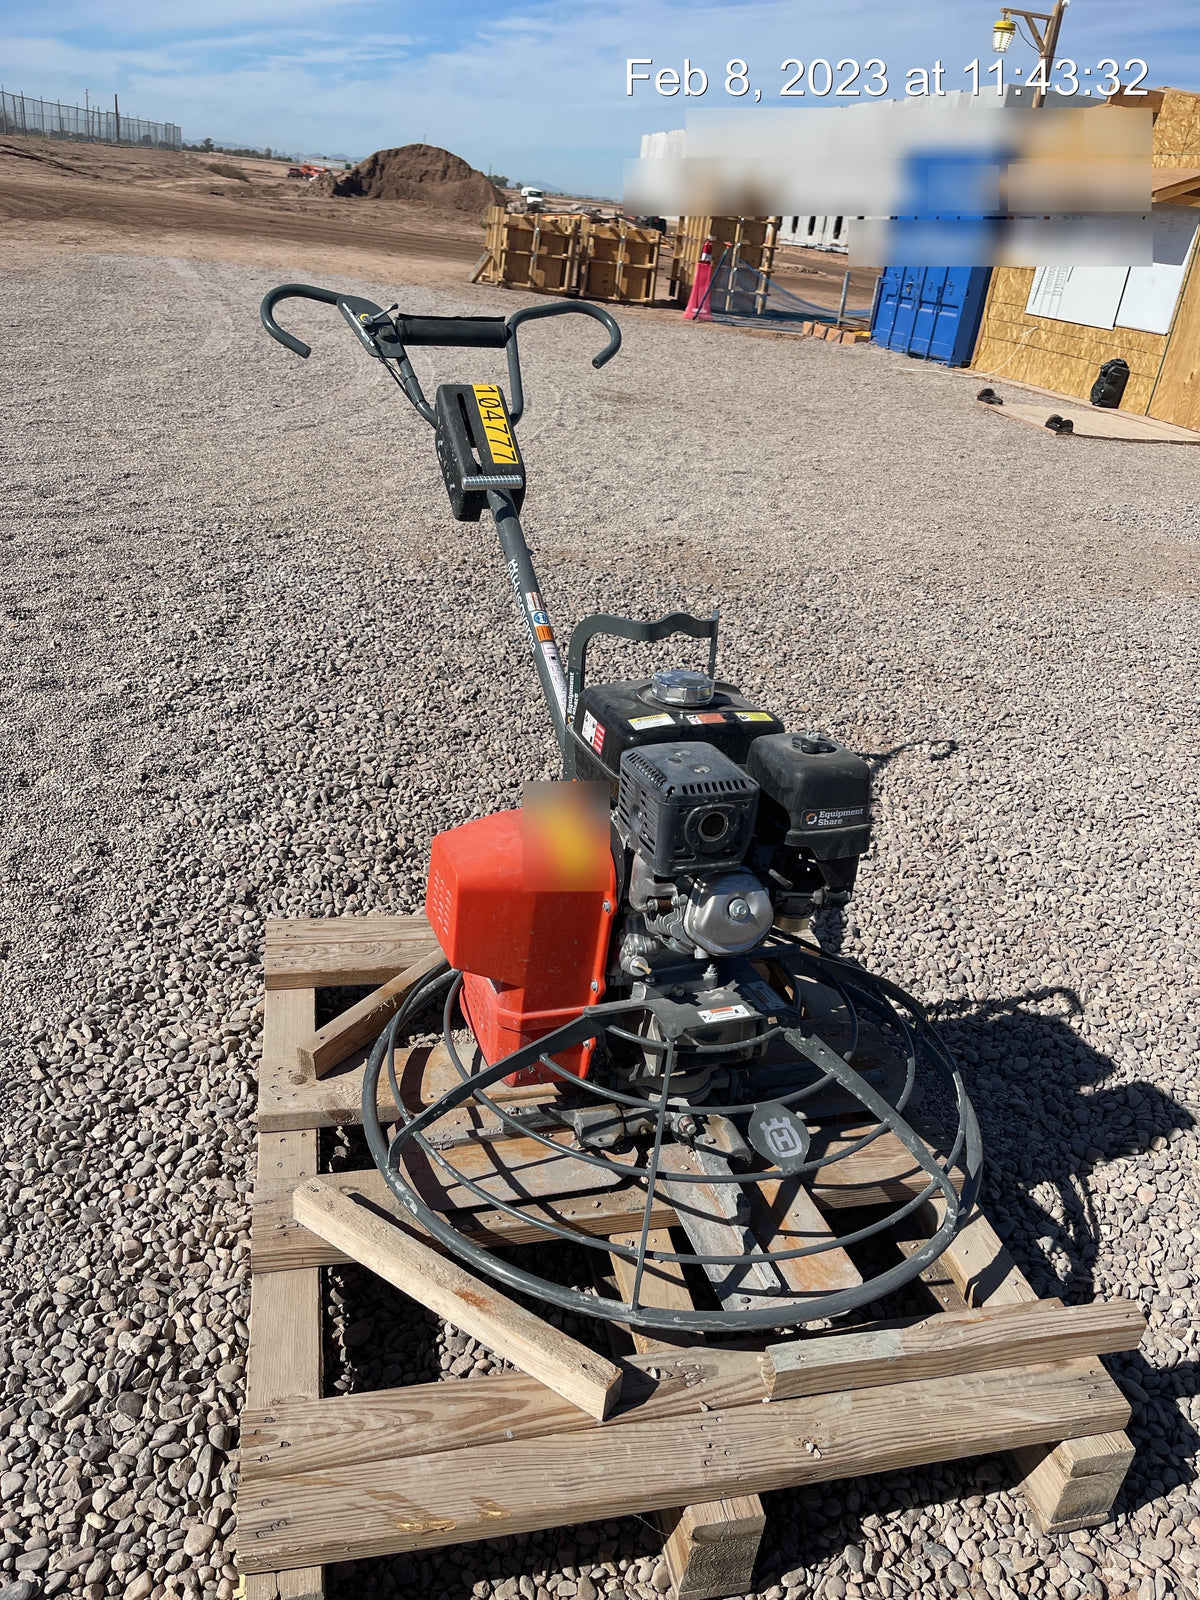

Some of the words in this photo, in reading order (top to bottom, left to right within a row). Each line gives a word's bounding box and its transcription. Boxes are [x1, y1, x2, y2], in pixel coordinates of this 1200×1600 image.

[475, 386, 517, 463] 104777
[566, 671, 575, 714] Equipment
[817, 818, 843, 826] Share
[818, 808, 864, 819] Equipment
